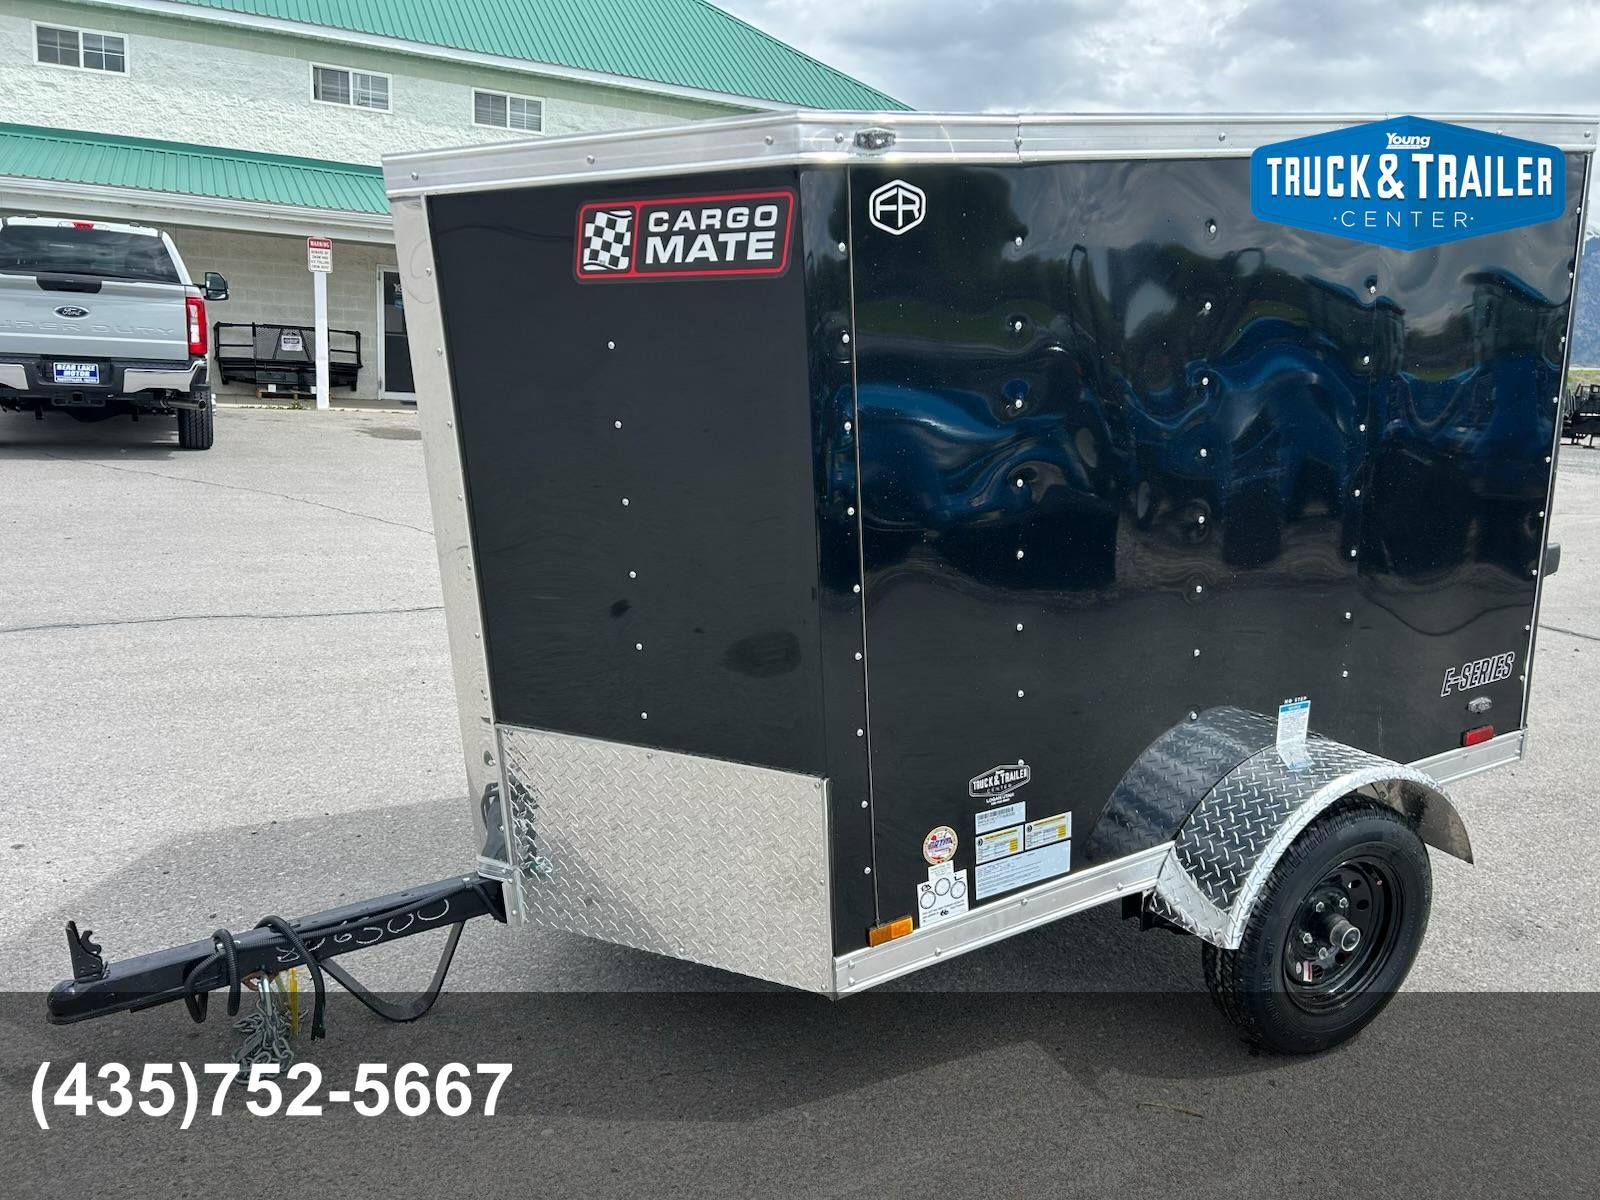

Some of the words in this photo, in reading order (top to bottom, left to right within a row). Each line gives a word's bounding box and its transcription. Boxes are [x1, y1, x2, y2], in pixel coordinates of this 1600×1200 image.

[648, 204, 778, 233] CARGO
[309, 240, 330, 248] WARNING
[645, 231, 777, 265] MATE
[62, 306, 82, 317] Ford
[92, 324, 175, 336] DUTY
[77, 364, 96, 372] LAKE
[1440, 651, 1515, 697] E-SERIES
[973, 776, 993, 790] TRUCK
